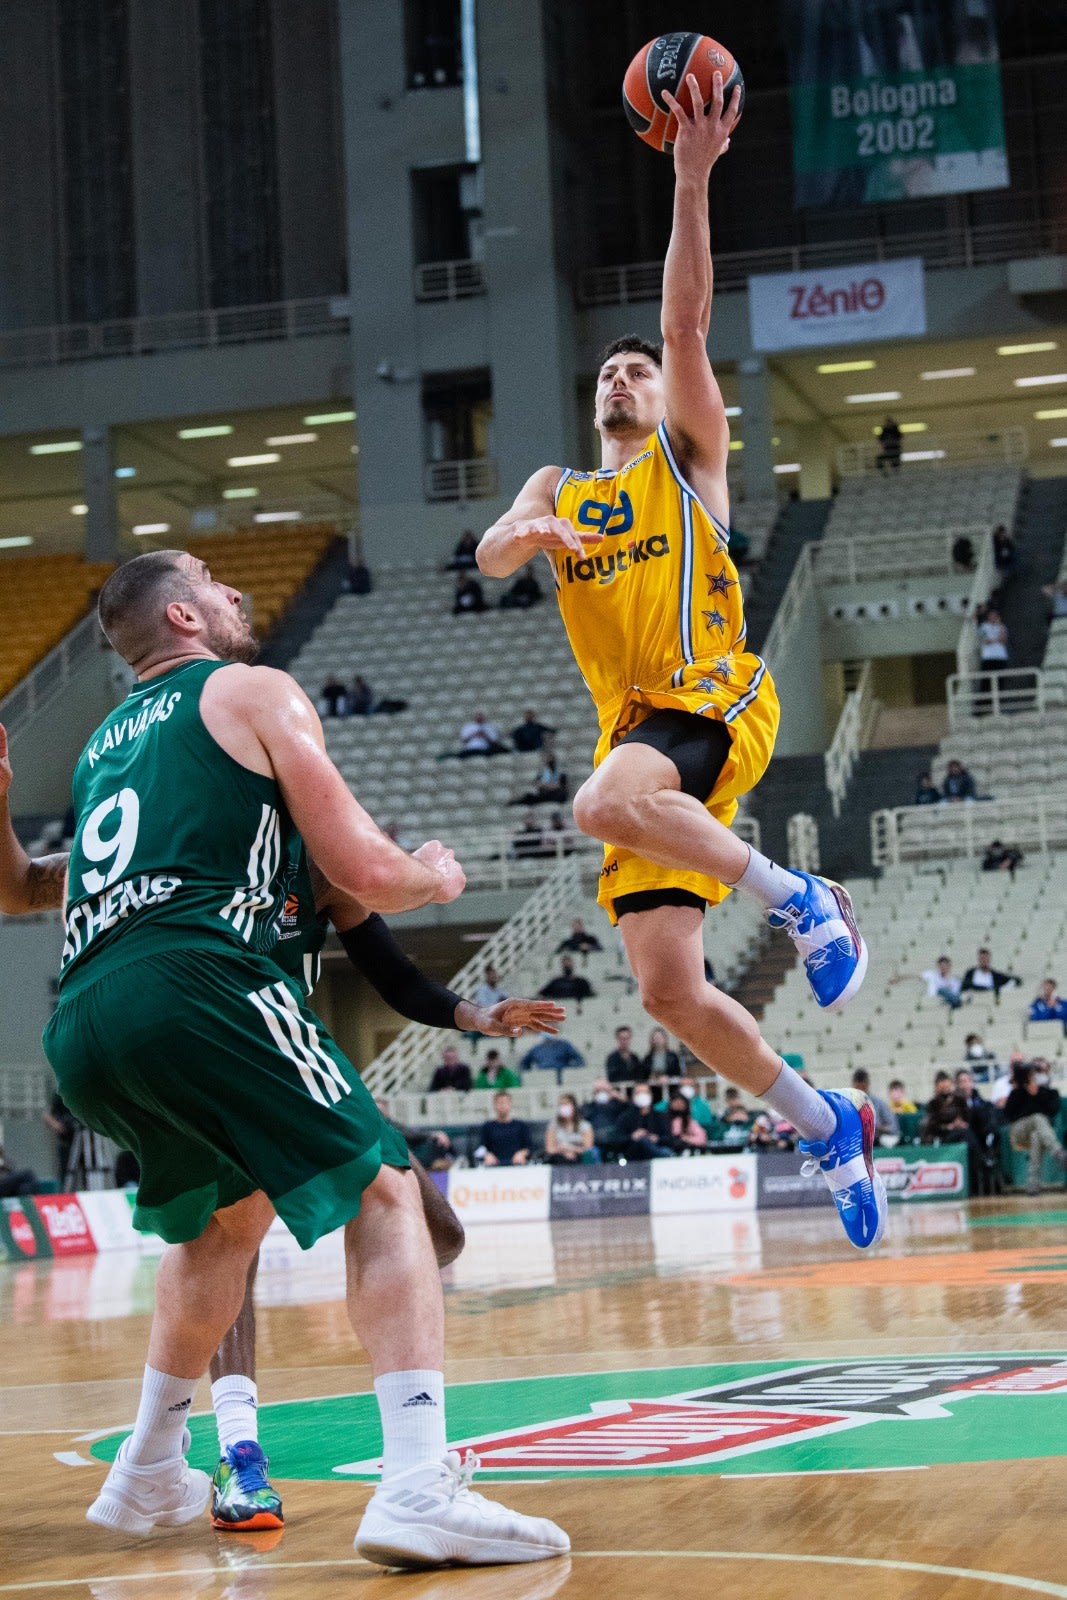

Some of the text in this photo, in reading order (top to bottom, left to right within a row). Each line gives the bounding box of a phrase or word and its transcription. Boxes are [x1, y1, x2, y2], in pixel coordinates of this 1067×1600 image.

[831, 79, 957, 118] Bologna
[857, 116, 934, 156] 2002
[562, 534, 670, 585] laytika
[88, 691, 182, 769] KAVVAAS
[81, 787, 140, 894] 9
[61, 875, 183, 970] ATHENS
[453, 1183, 545, 1208] Quince
[552, 1177, 647, 1195] MATRIX
